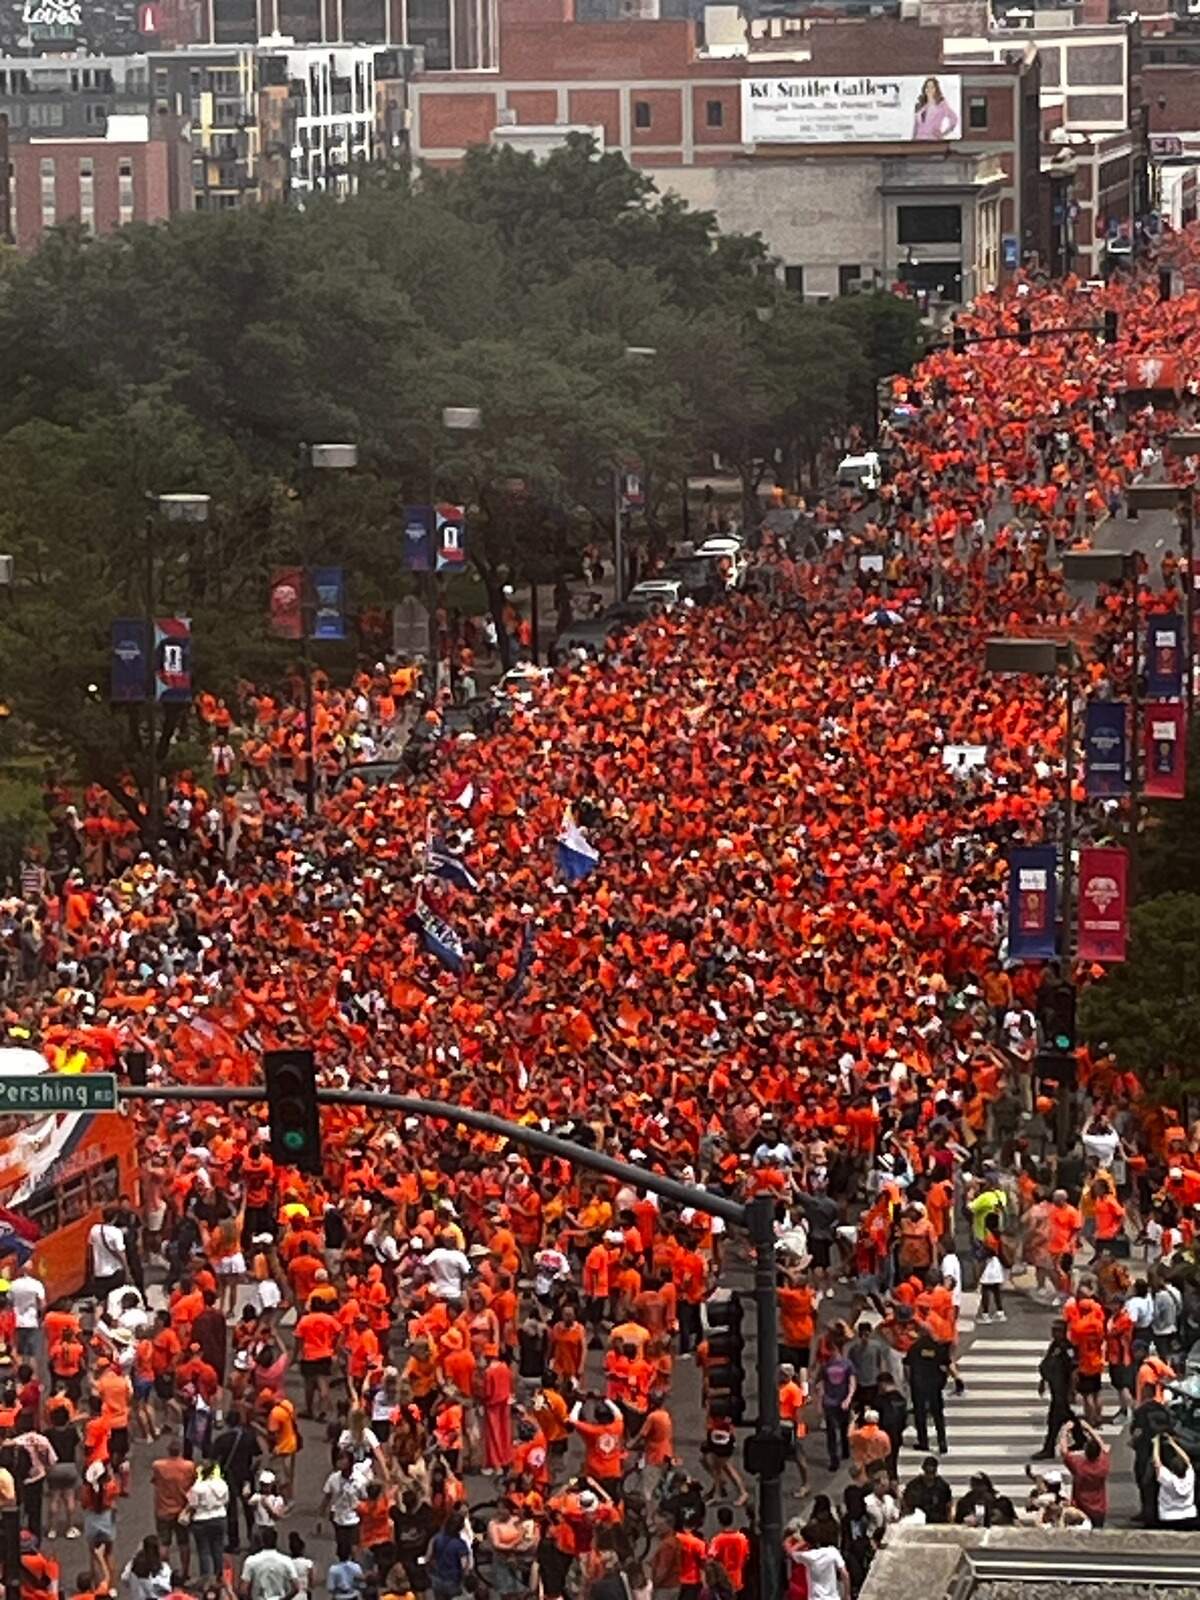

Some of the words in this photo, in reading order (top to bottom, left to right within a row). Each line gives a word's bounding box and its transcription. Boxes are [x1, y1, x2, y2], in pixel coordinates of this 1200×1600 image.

[750, 83, 772, 98] KC
[777, 81, 830, 98] Smile
[834, 79, 901, 100] Gallery
